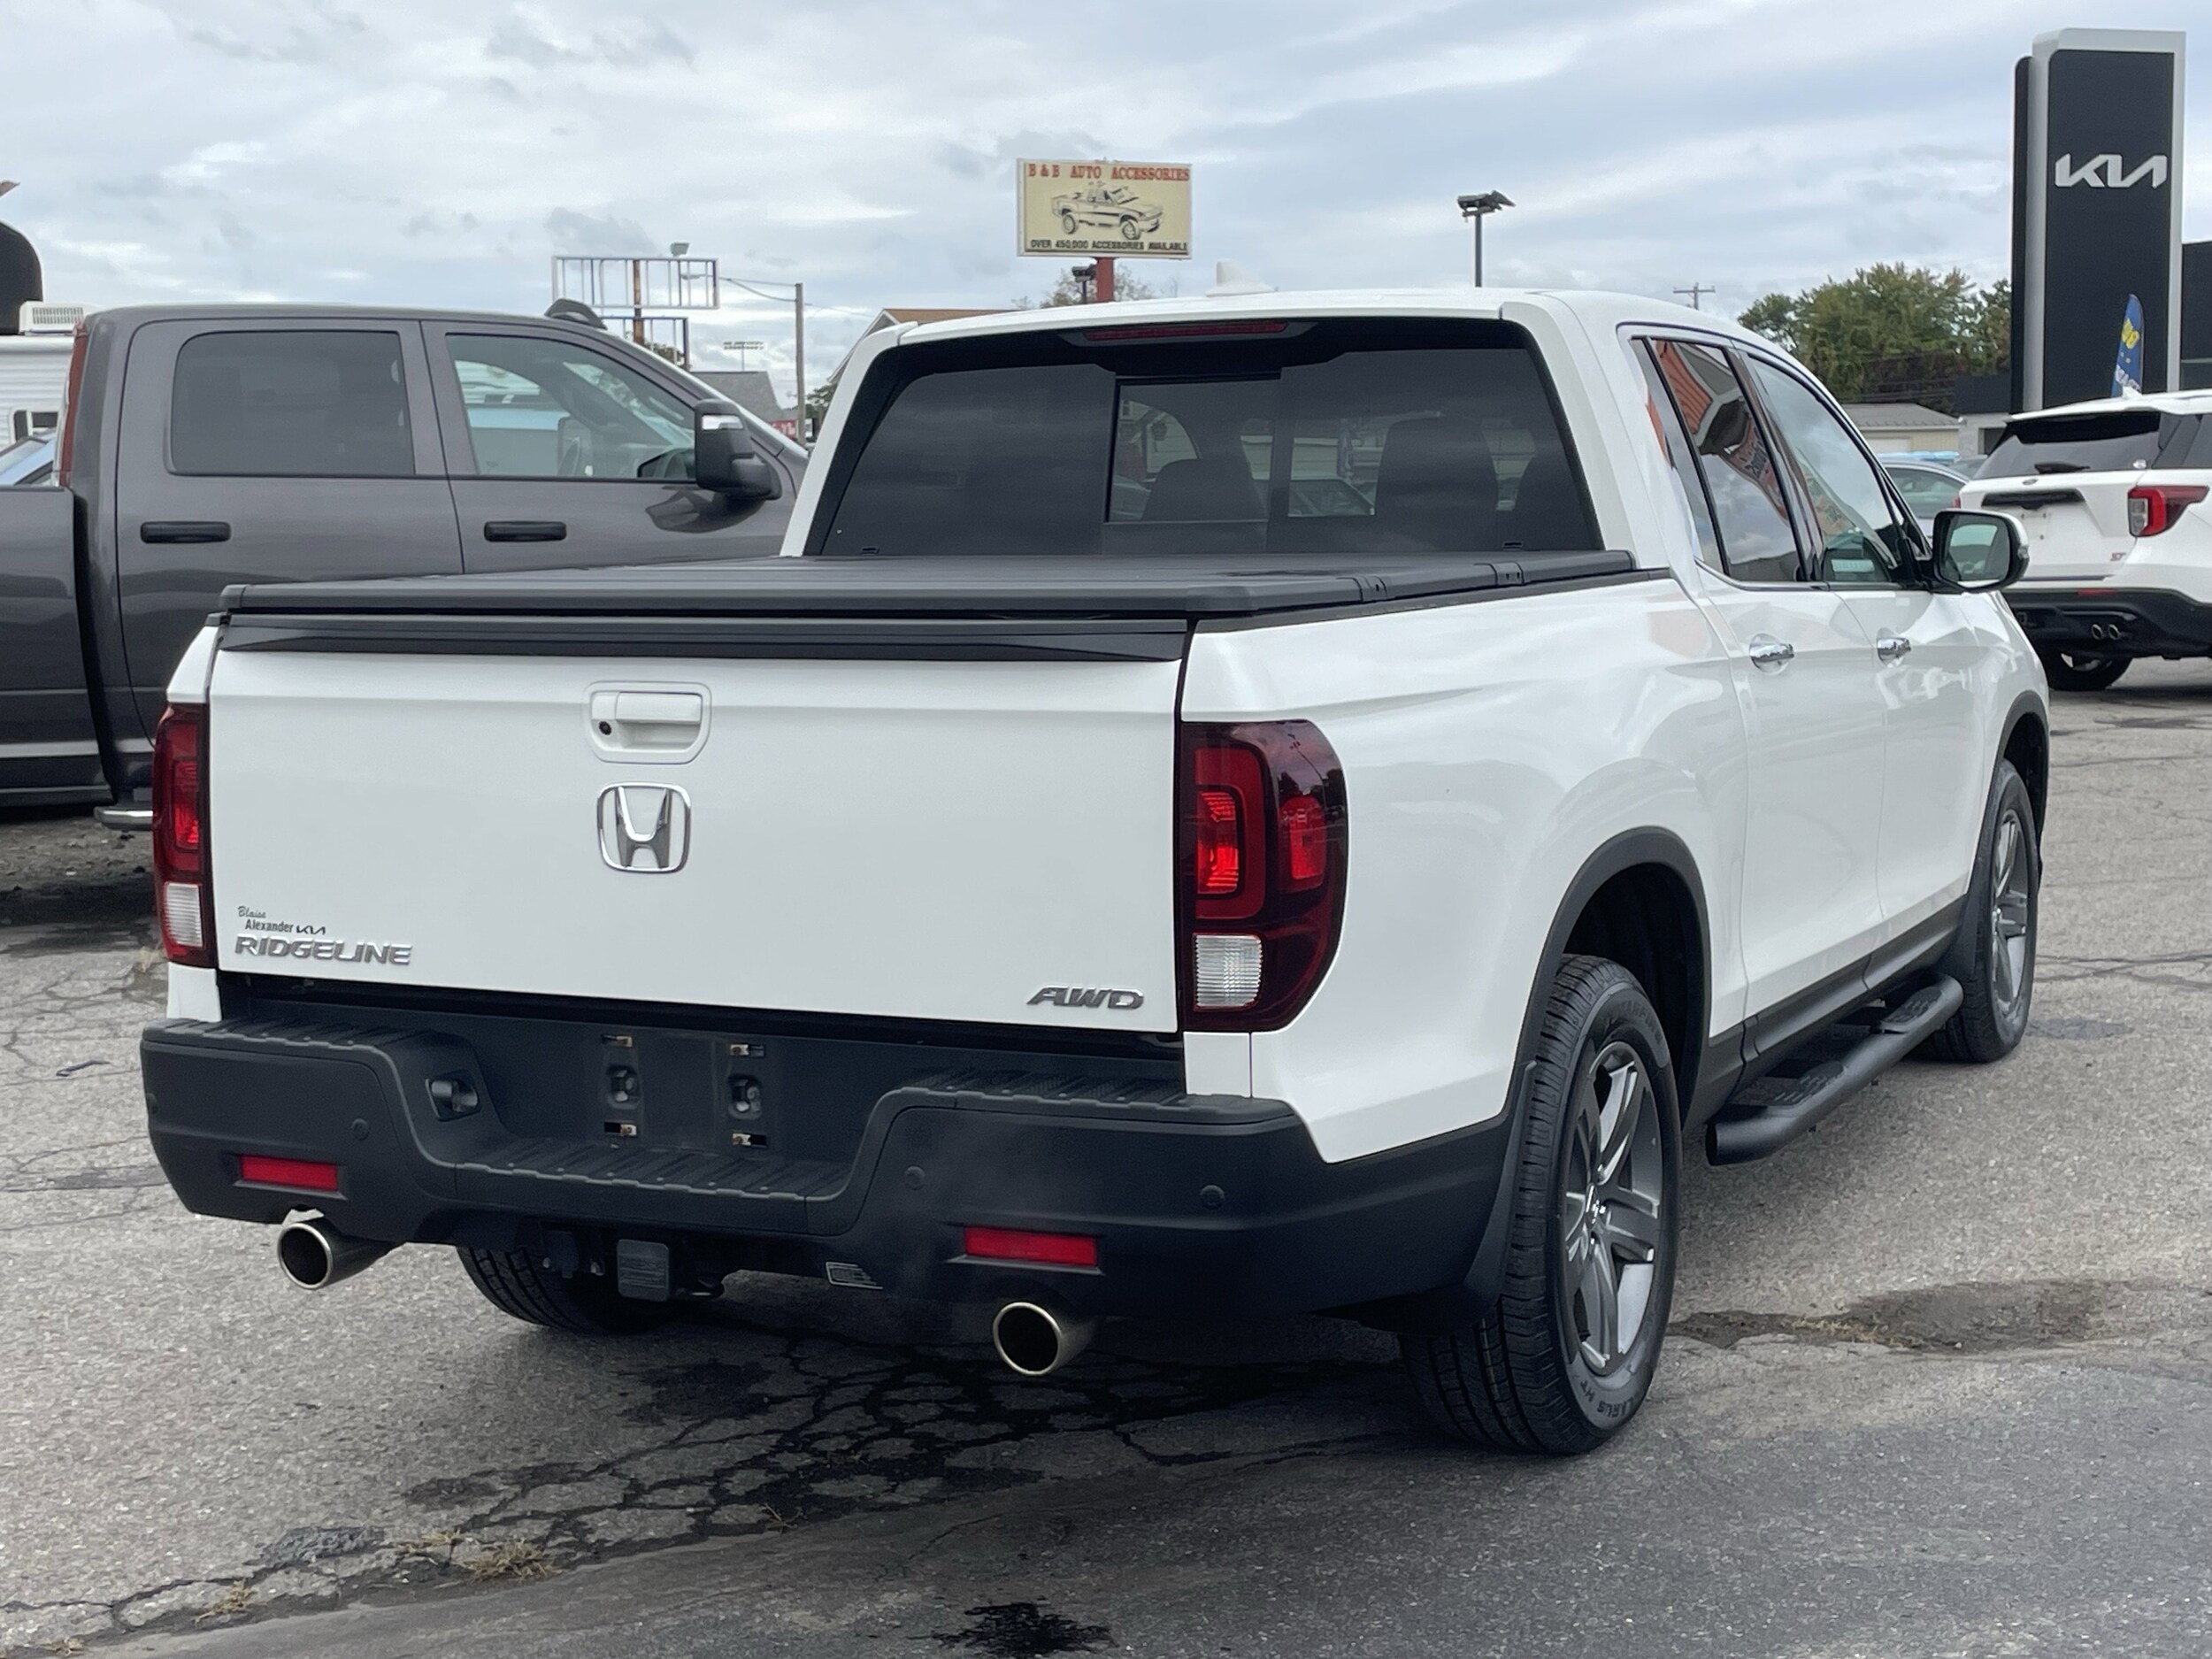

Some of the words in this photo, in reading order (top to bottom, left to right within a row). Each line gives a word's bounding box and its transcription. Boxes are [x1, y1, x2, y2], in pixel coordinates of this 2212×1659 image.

[1028, 163, 1036, 177] B
[1041, 164, 1048, 177] &
[1070, 165, 1102, 179] AUTO
[1111, 166, 1190, 181] ACCESSORIES
[2055, 153, 2168, 188] KIA
[1031, 239, 1051, 248] OVER
[1092, 240, 1144, 250] ACCESSORIES
[1148, 242, 1187, 250] AVAILABLE
[245, 918, 294, 933] Alexander
[234, 933, 413, 965] RIDGELINE
[1026, 985, 1145, 1010] AWD
